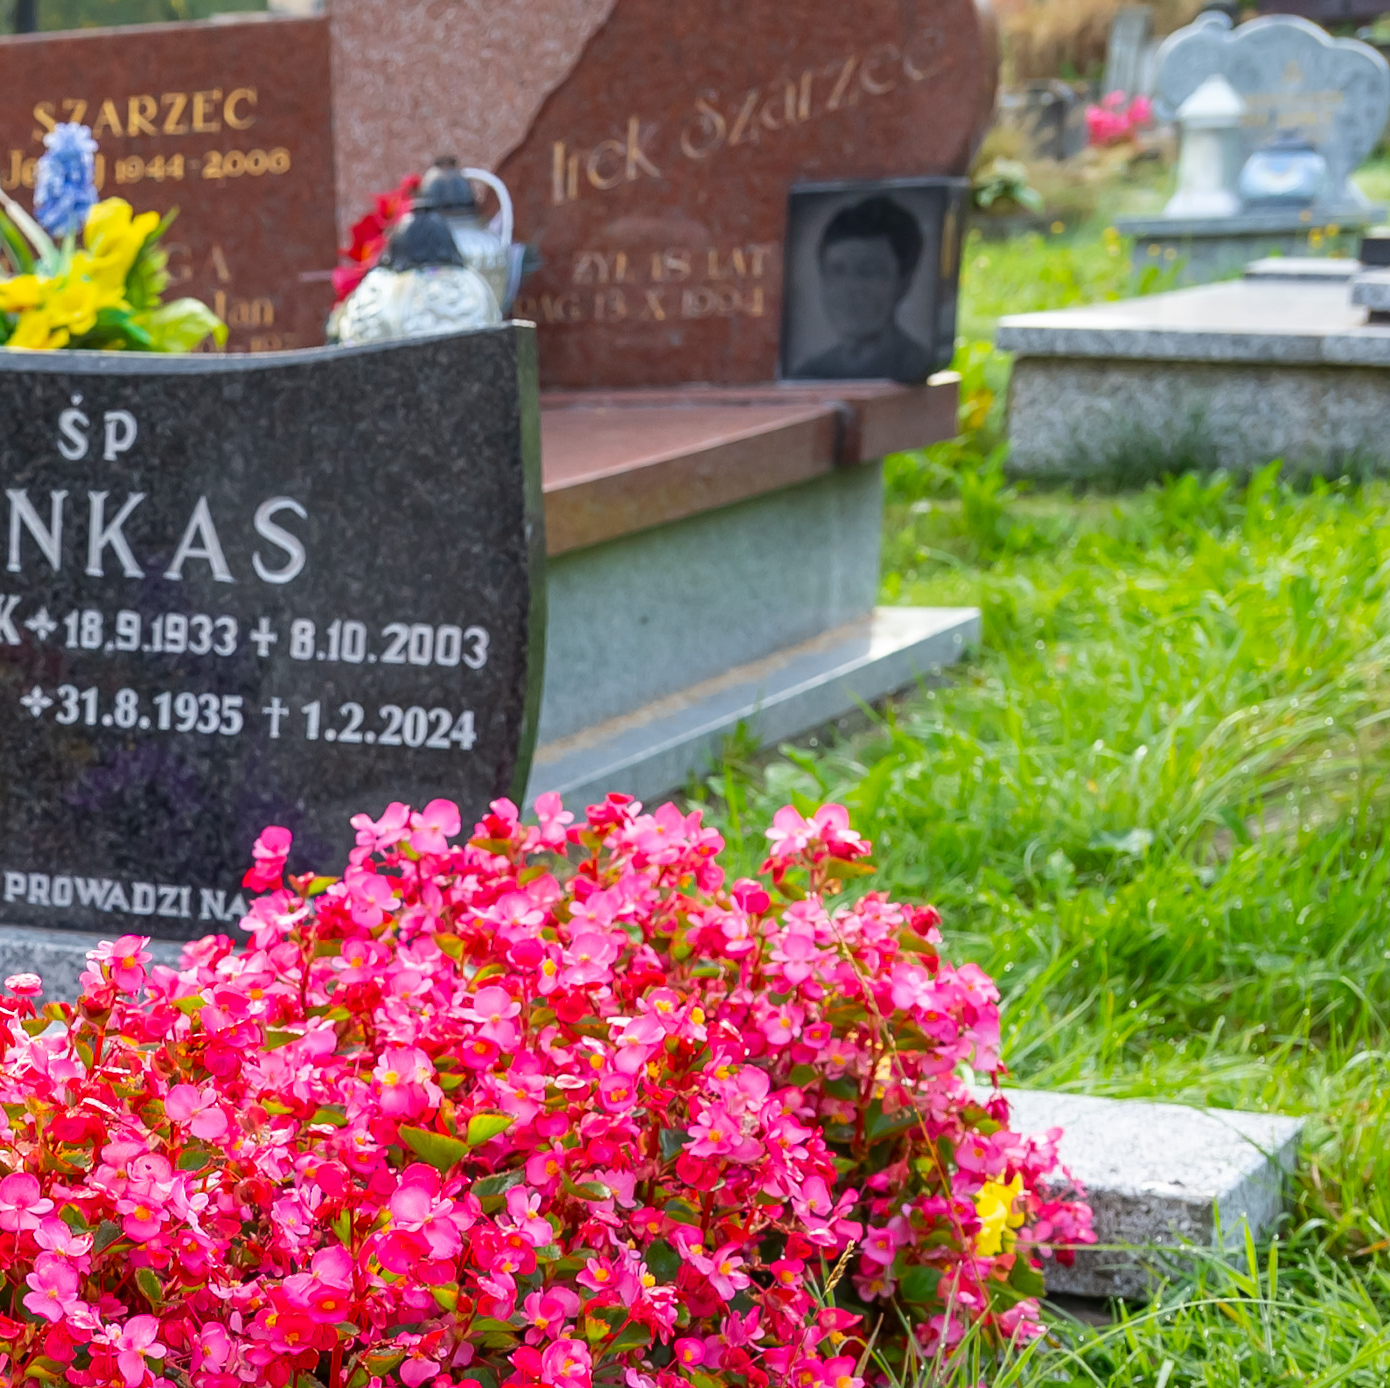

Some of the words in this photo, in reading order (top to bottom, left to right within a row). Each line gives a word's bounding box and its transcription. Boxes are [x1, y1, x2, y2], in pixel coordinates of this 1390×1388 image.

[32, 87, 258, 141] SZARZEC
[115, 153, 185, 184] 1944
[63, 608, 239, 656] 18.9.1933
[289, 618, 490, 670] 8.10.2003
[55, 683, 244, 736] 31.8.1935
[302, 700, 478, 751] 1.2.2024
[4, 871, 193, 919] PROWADZI
